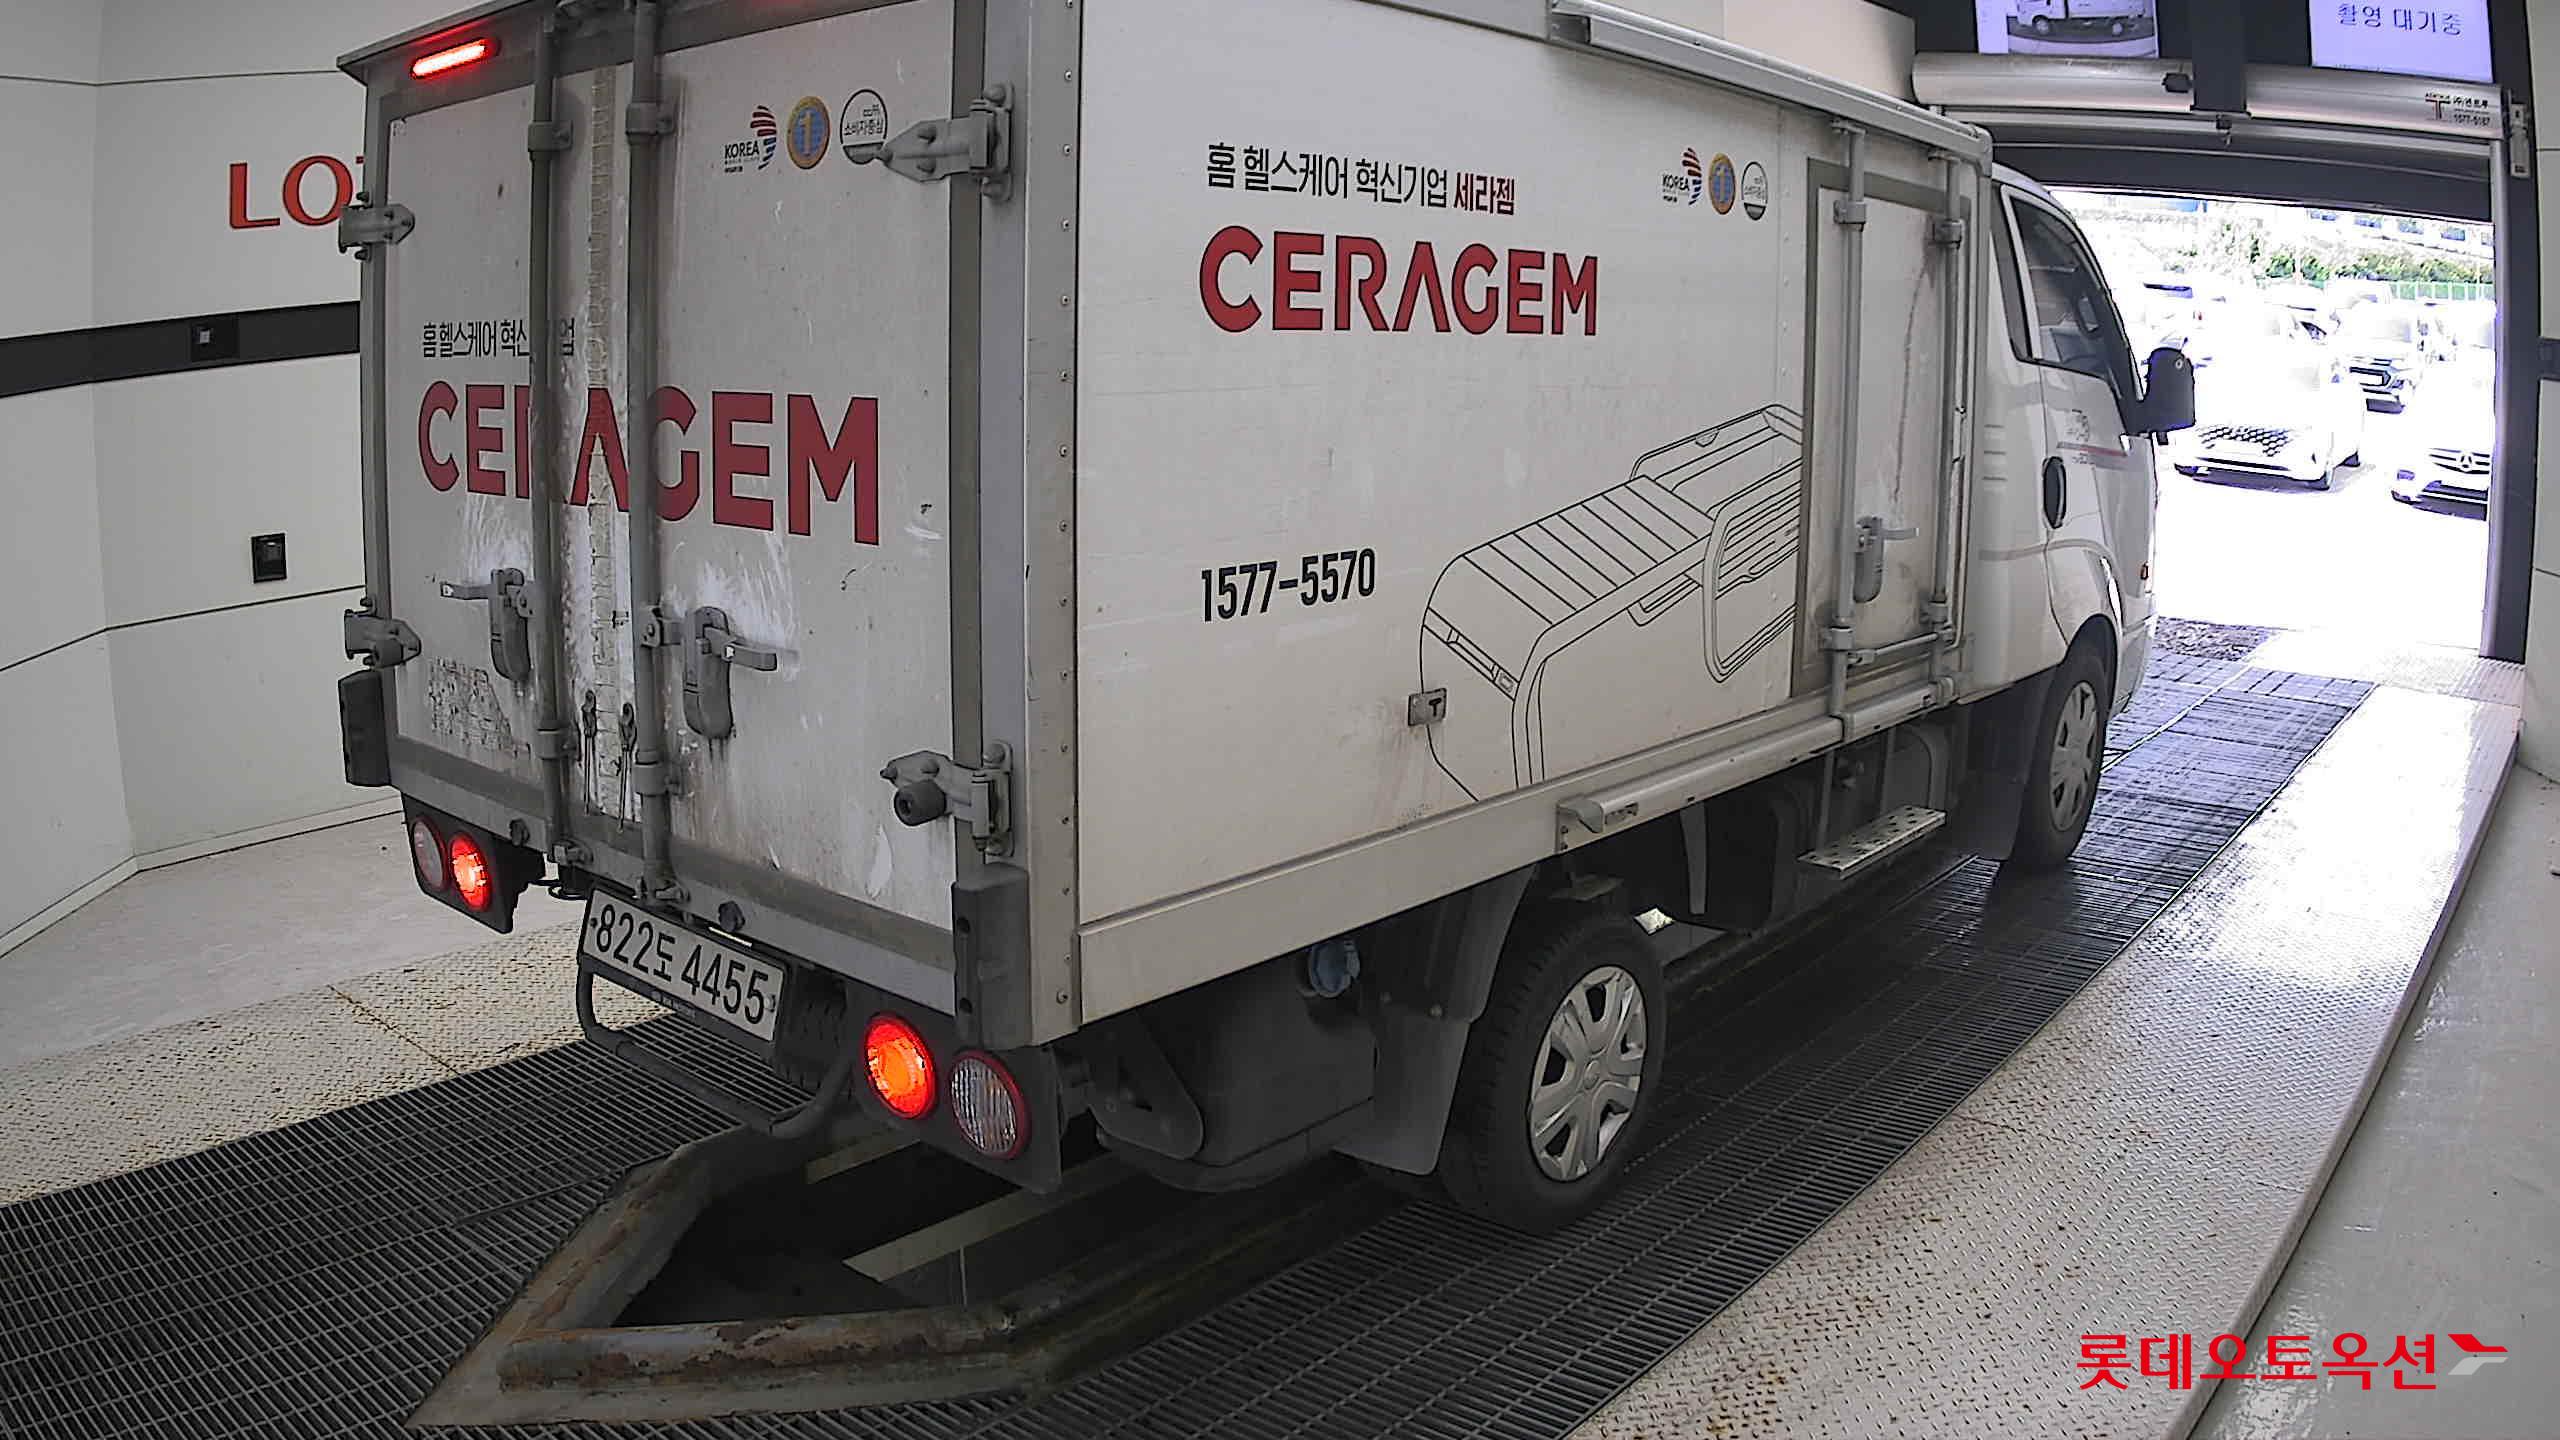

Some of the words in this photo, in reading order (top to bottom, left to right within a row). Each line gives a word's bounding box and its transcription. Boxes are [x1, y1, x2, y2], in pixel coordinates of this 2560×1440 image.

[2338, 3, 2381, 28] 촬영
[2393, 8, 2461, 36] 대기중
[724, 140, 760, 159] KOREA
[1206, 142, 1236, 189] 홈
[1243, 145, 1349, 199] 헬스케어
[1355, 158, 1448, 208] 혁신기업
[1453, 171, 1516, 217] 세라젬
[229, 154, 365, 230] LO
[1199, 225, 1599, 337] CERAGEM
[422, 321, 437, 358] 홈
[439, 320, 497, 358] 헬스케어
[500, 317, 575, 358] 혁신업
[1201, 547, 1376, 622] 1577-5570
[680, 943, 770, 1025] 4455
